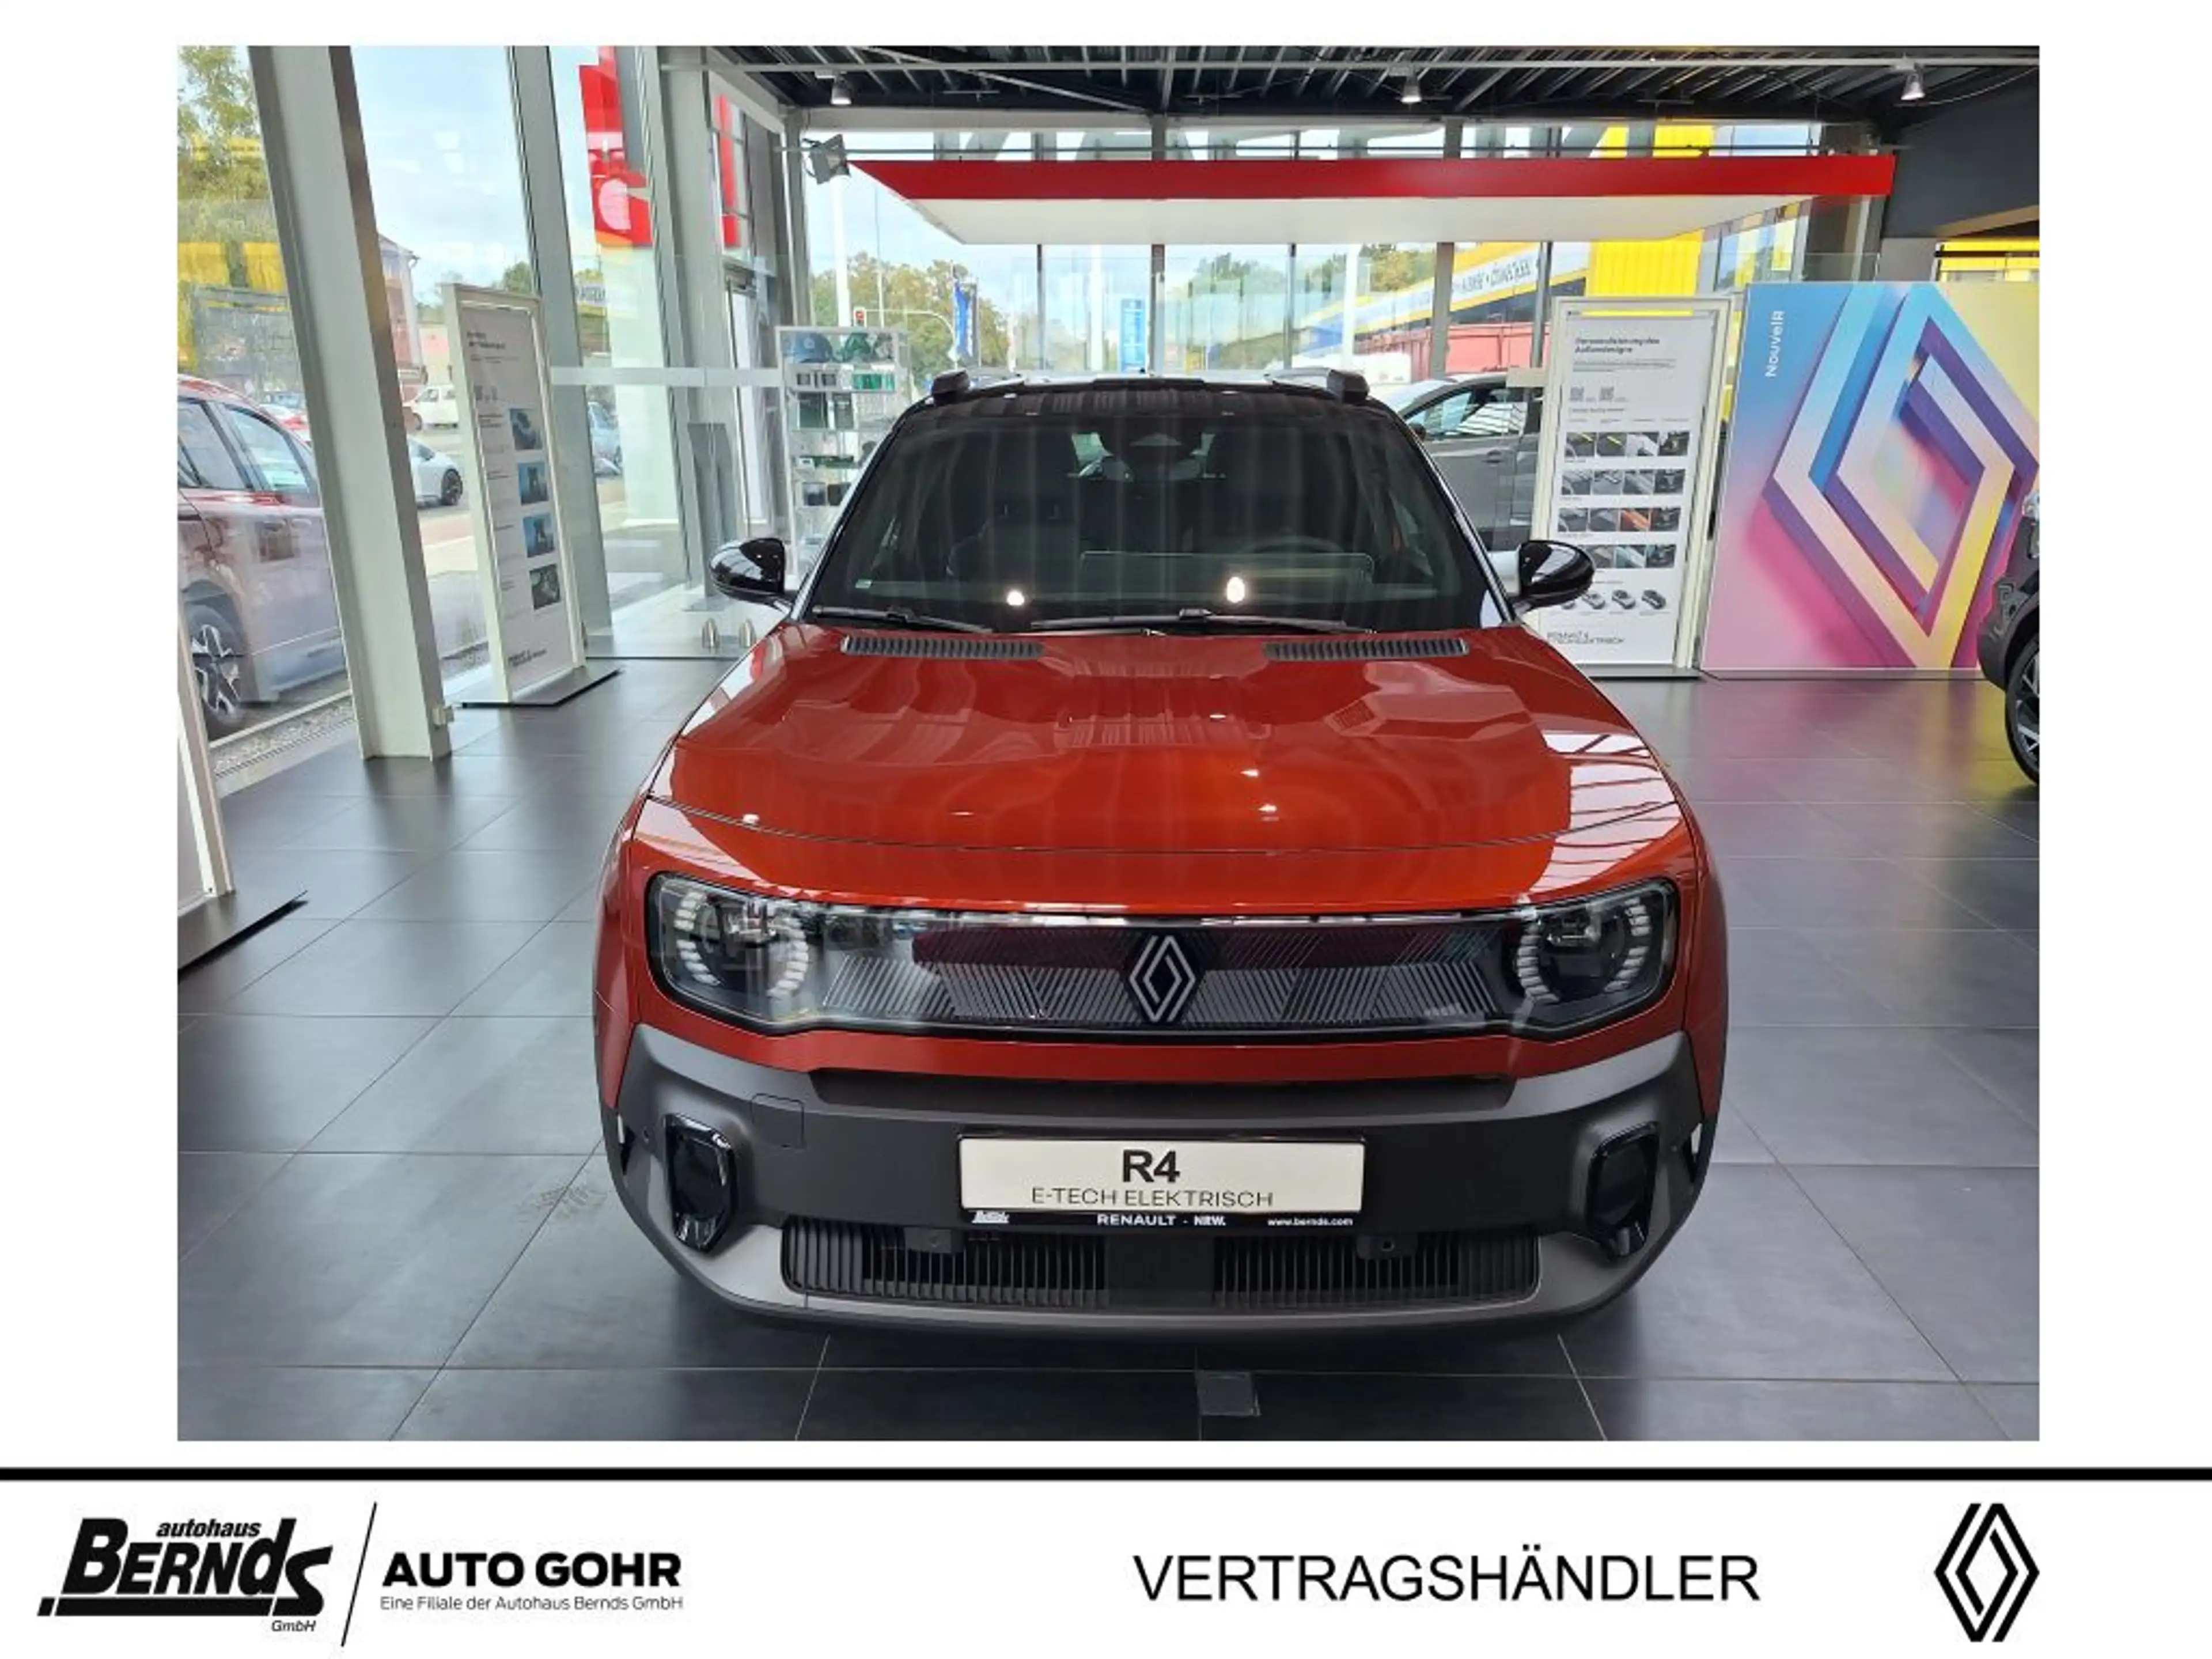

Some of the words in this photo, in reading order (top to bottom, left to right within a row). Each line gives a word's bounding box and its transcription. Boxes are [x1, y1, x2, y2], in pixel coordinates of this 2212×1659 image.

[1123, 1149, 1181, 1183] R4
[1031, 1187, 1116, 1206] E-TECH
[1124, 1190, 1274, 1208] ELEKTRISCH
[1097, 1213, 1176, 1226] RENAULT
